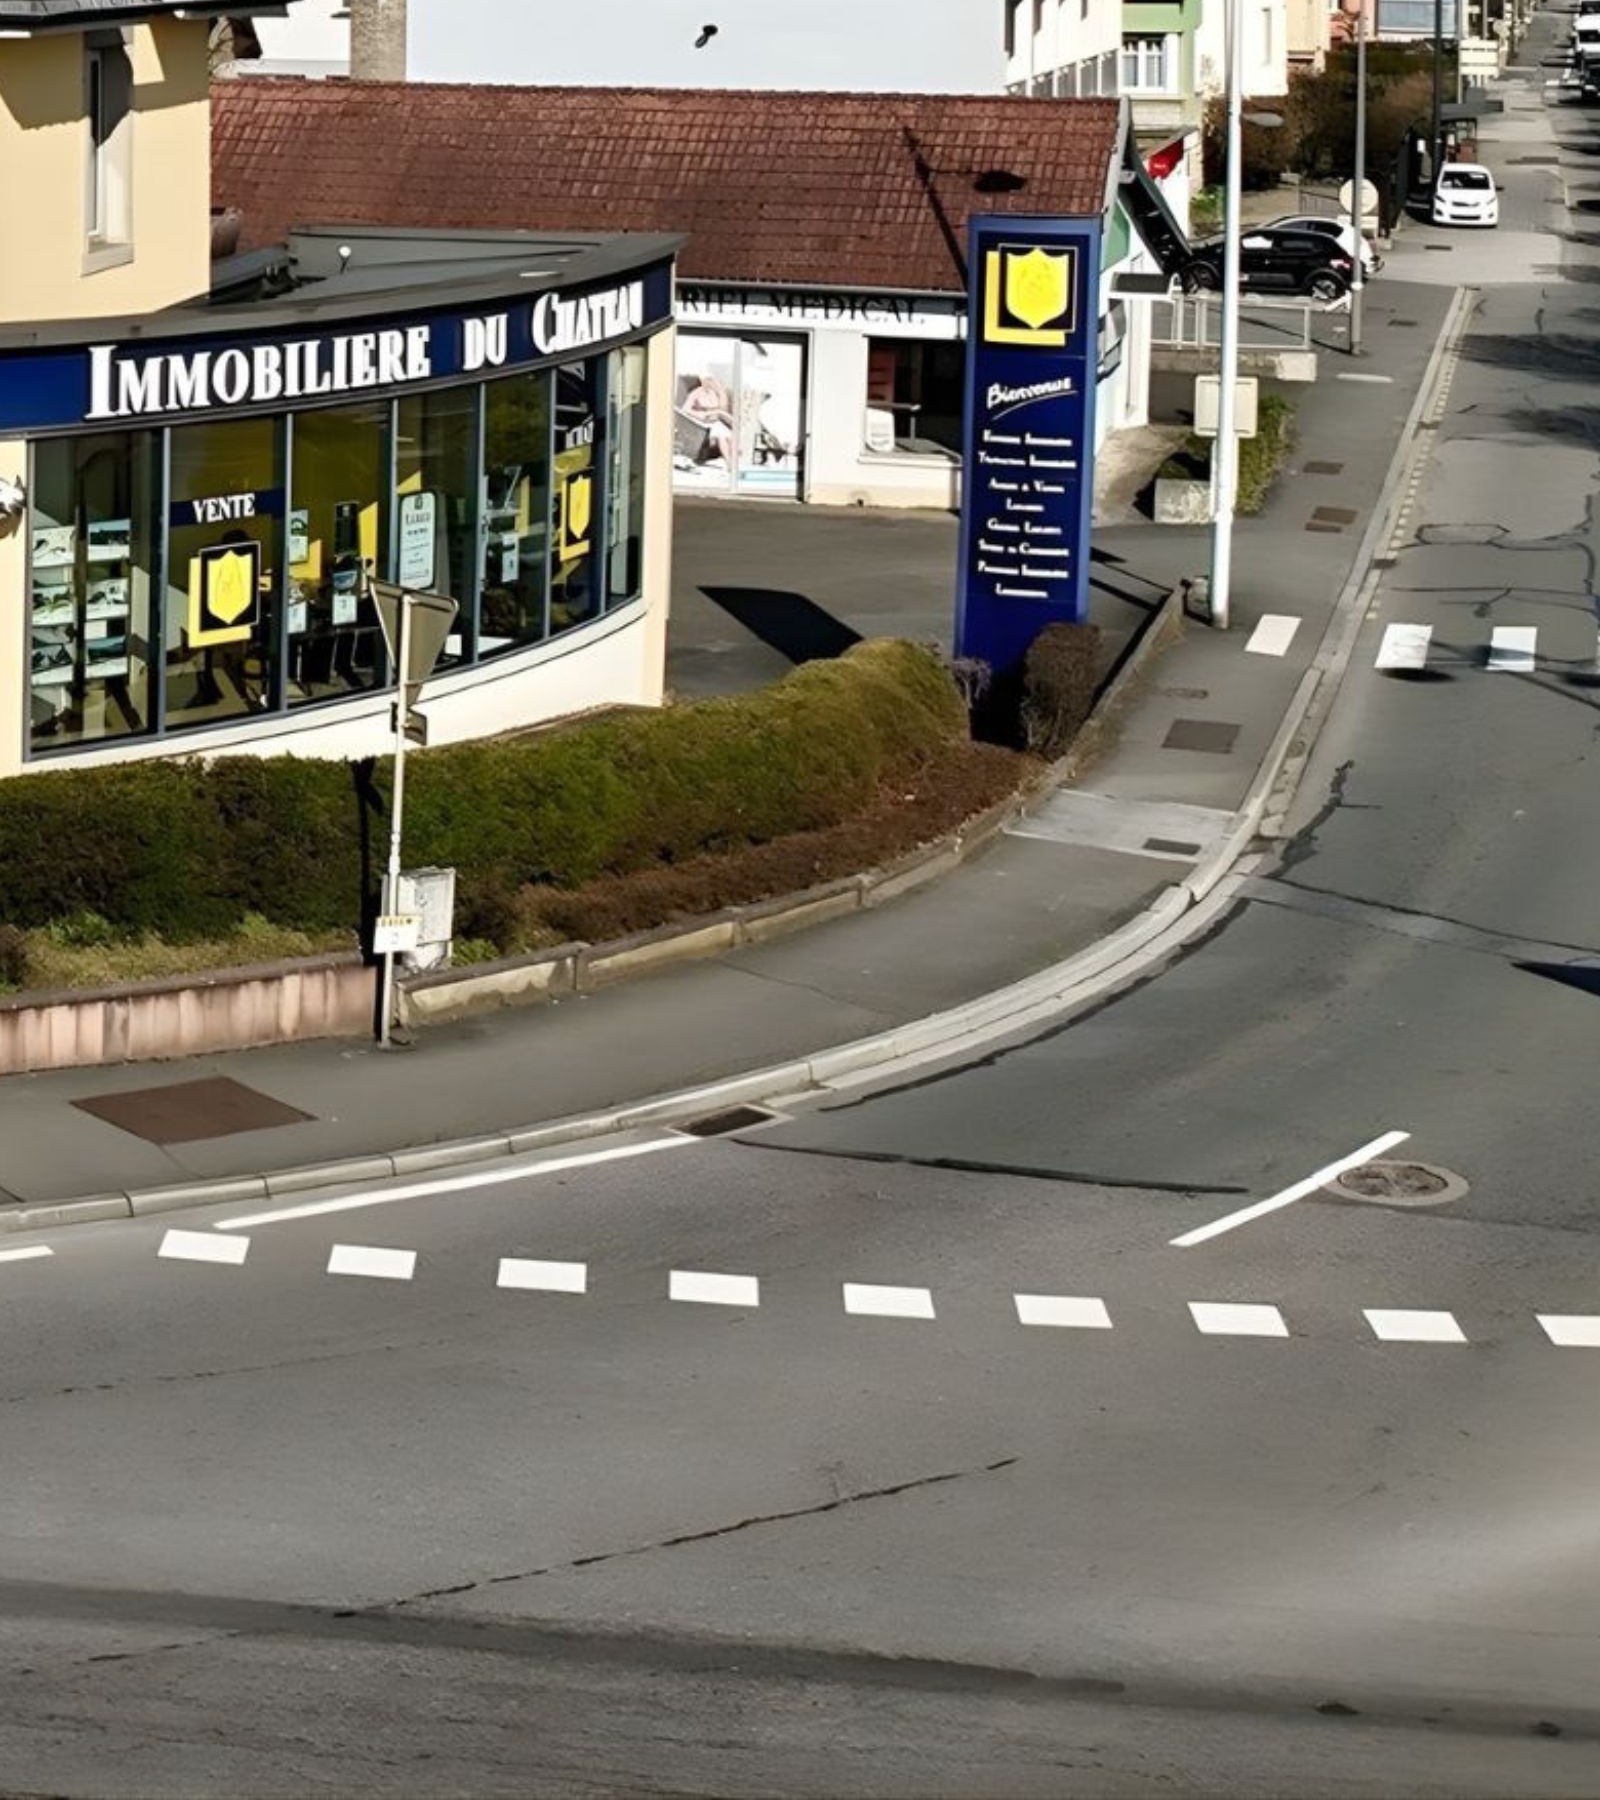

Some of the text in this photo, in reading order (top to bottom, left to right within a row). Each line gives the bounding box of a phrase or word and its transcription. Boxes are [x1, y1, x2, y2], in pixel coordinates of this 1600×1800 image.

[84, 324, 430, 420] IMMOBILIERE
[462, 313, 508, 371] DU
[192, 491, 256, 524] VENTE
